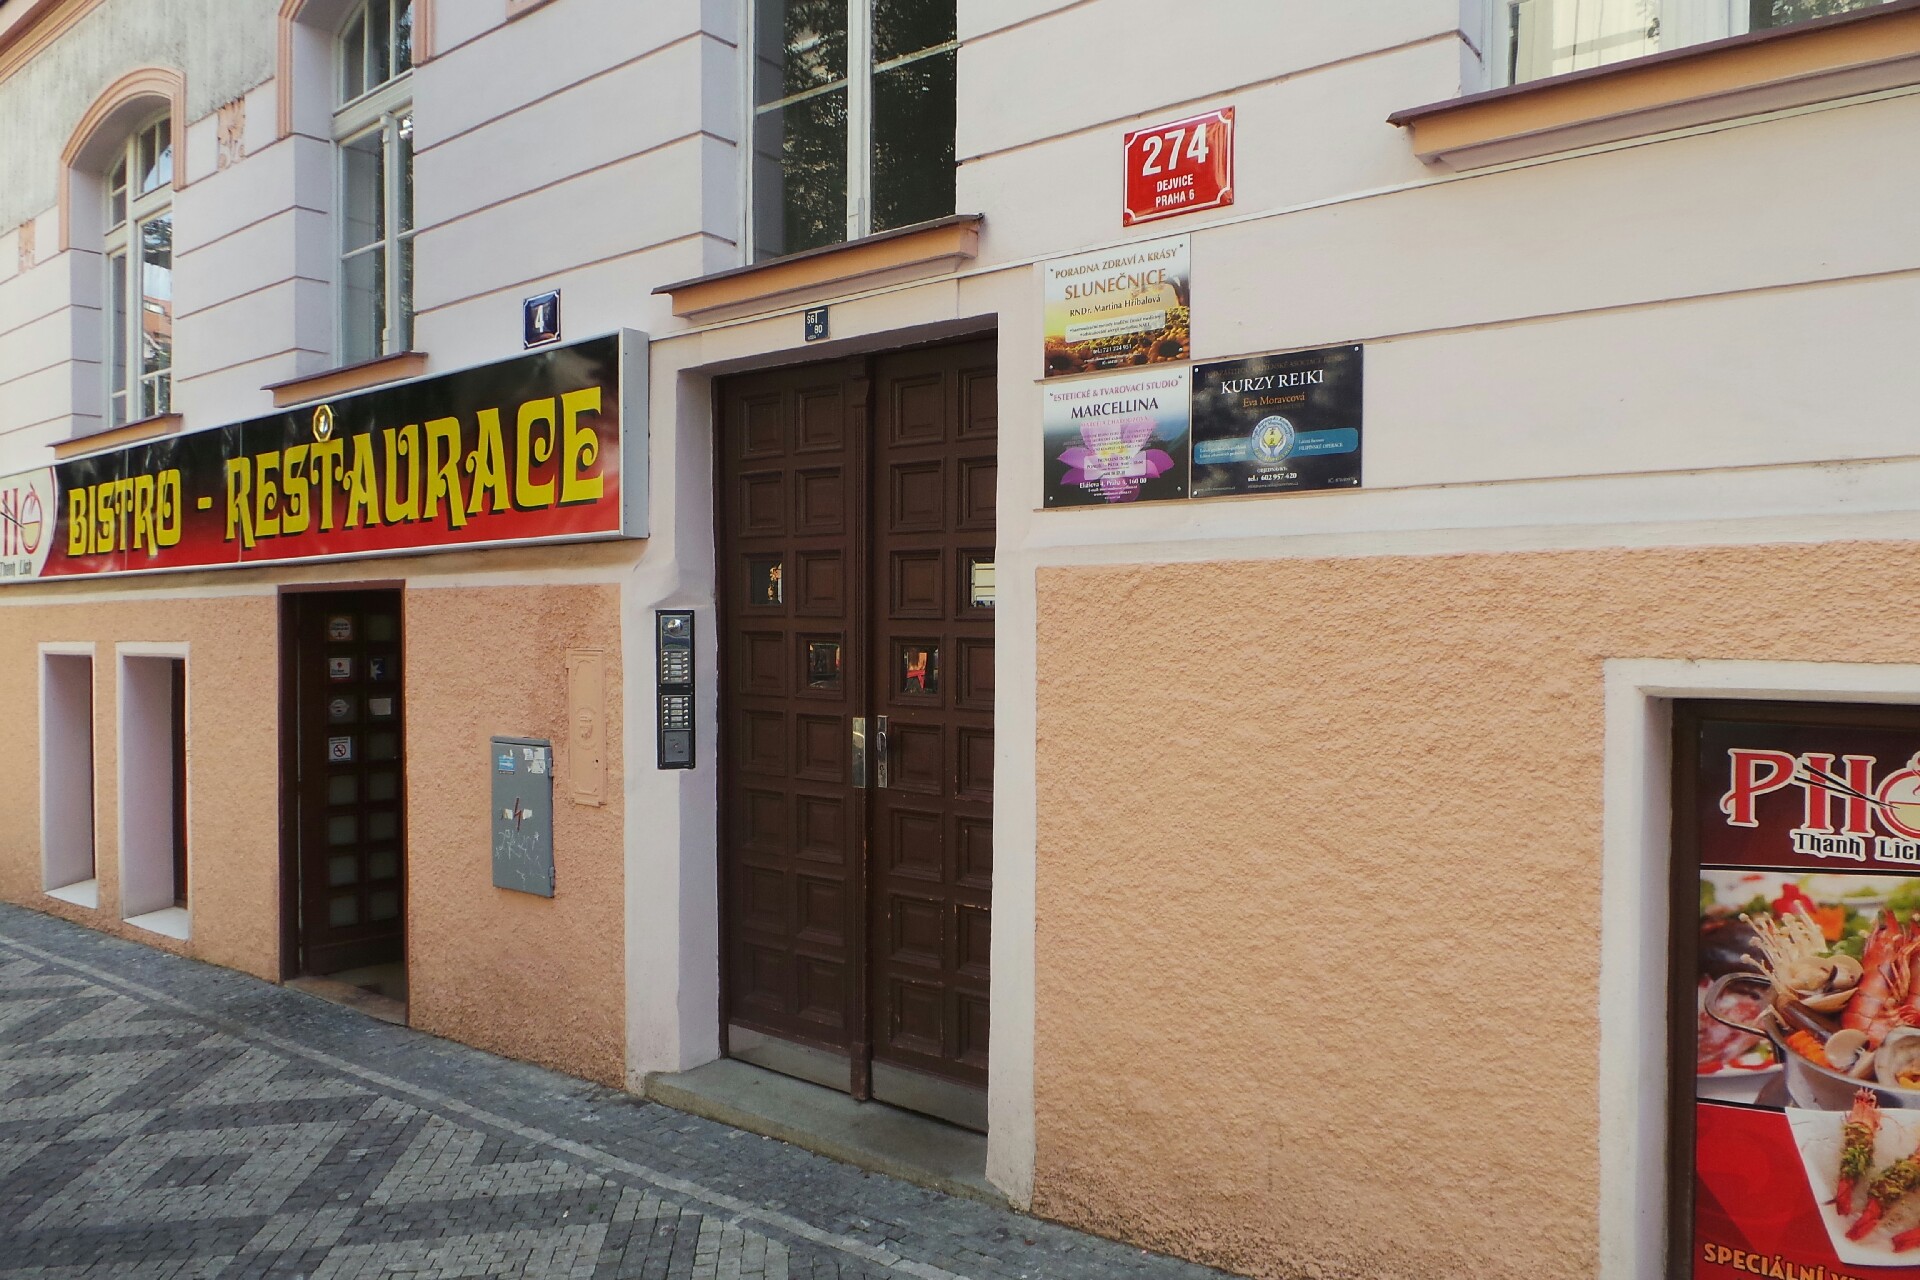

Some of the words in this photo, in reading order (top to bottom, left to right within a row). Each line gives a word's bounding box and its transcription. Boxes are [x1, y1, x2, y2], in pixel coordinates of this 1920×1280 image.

[1142, 122, 1209, 177] 274
[1156, 173, 1194, 193] DEJVICE
[1155, 191, 1187, 208] PRAHA
[1188, 189, 1195, 201] 6
[1055, 263, 1100, 279] PORADNA
[1102, 253, 1137, 270] ZDRAVÍ
[1138, 254, 1145, 264] A
[1147, 247, 1178, 262] KRÁSY
[1065, 268, 1167, 301] SLUNEČNICE
[534, 304, 545, 333] 4
[1069, 307, 1092, 317] RNDr.
[1094, 302, 1122, 313] Martina
[1053, 389, 1091, 402] ESTETICKÉ
[1092, 389, 1098, 397] &
[1100, 383, 1144, 397] TVAROVACÍ
[1146, 379, 1179, 391] STUDIO
[1220, 375, 1275, 395] KURZY
[1278, 369, 1324, 388] REIKI
[1071, 397, 1159, 419] MARCELLINA
[1243, 397, 1258, 408] Eva
[67, 469, 181, 557] BISTRO
[225, 386, 604, 549] RESTAURACE
[1260, 473, 1273, 481] 602
[1273, 473, 1284, 481] 957
[1285, 471, 1297, 479] 420
[1792, 830, 1864, 860] Thanh
[1703, 1242, 1826, 1280] SPECIÁLNÍ
